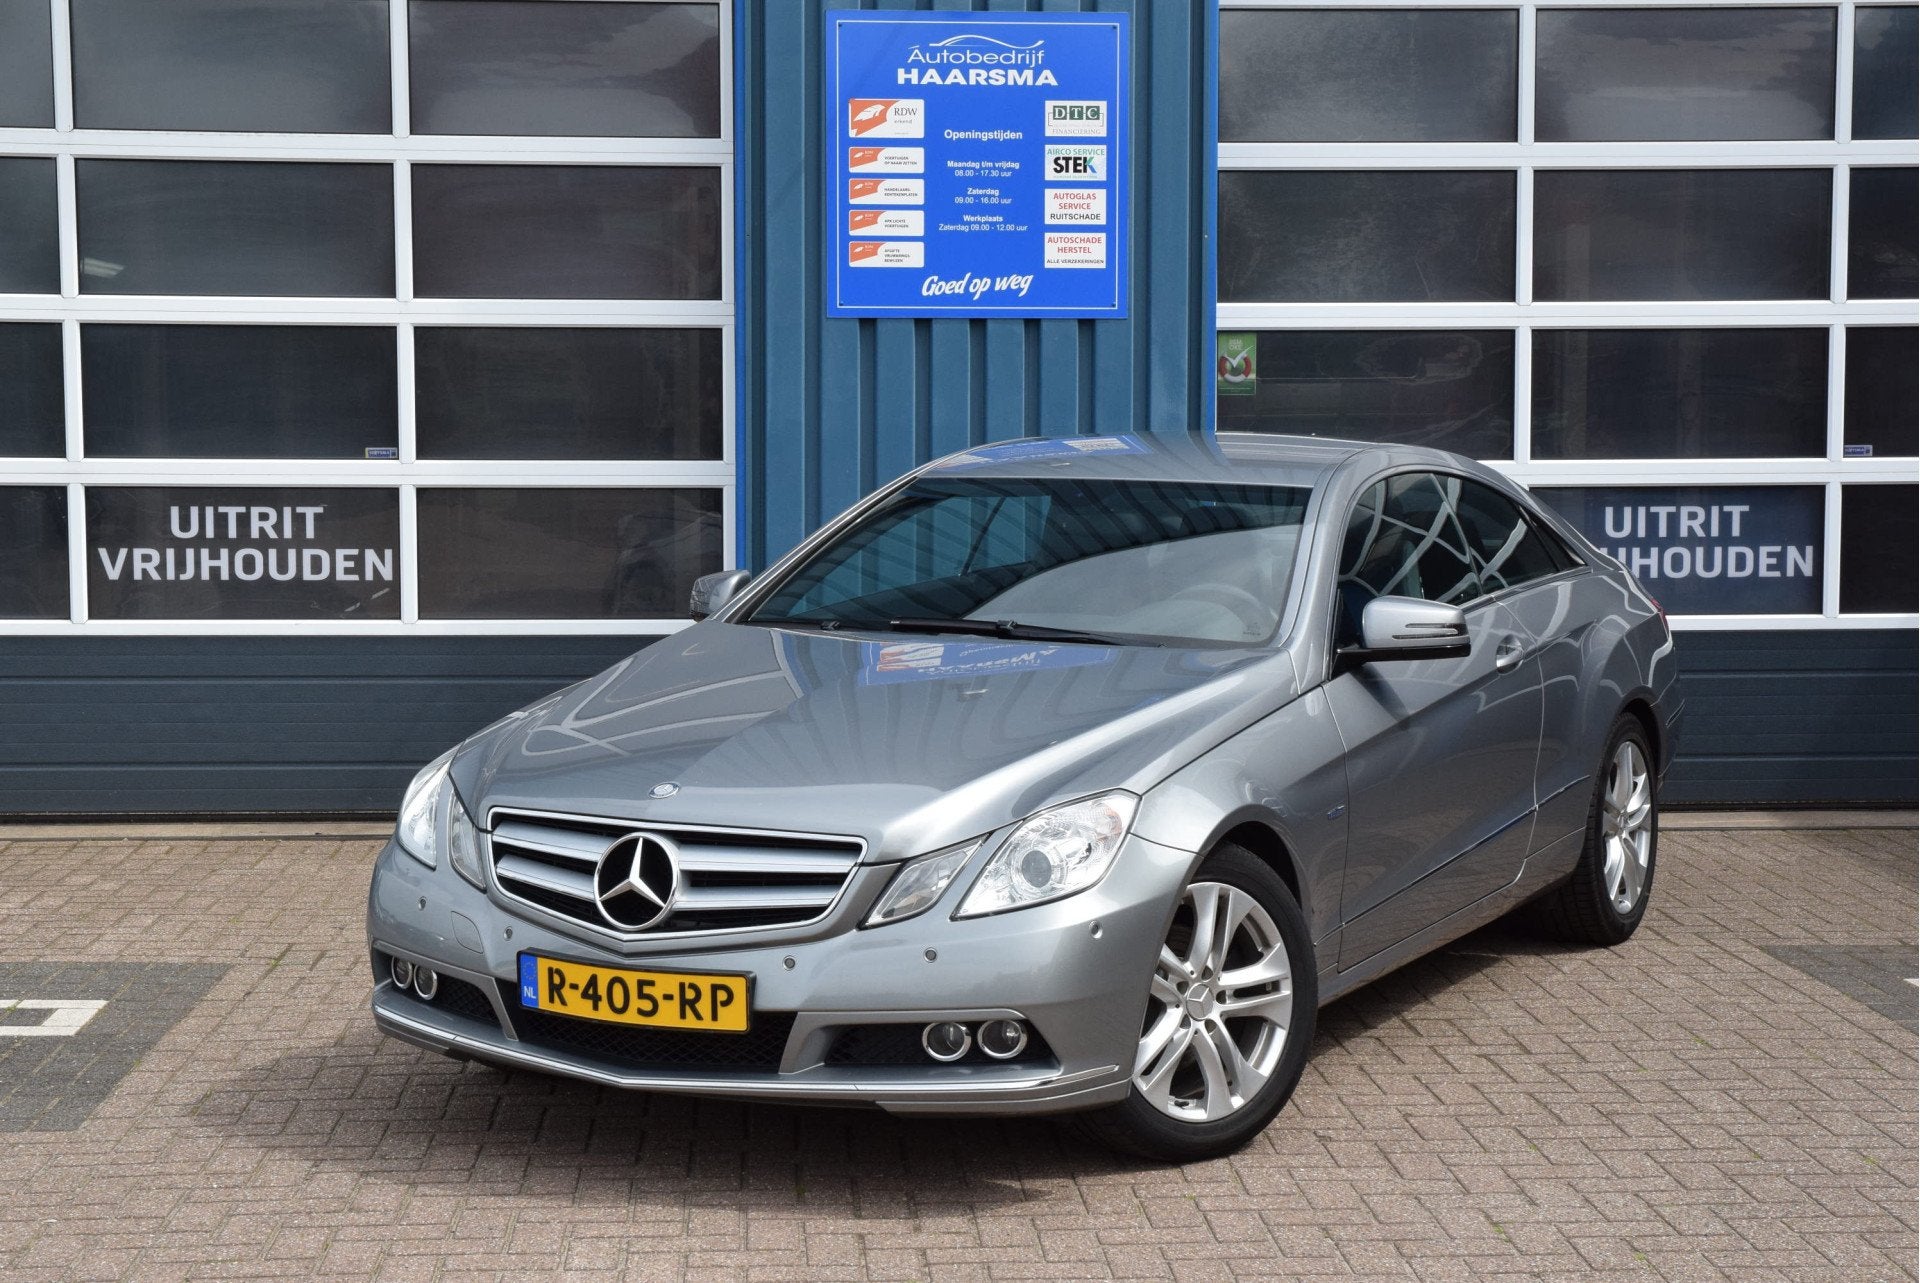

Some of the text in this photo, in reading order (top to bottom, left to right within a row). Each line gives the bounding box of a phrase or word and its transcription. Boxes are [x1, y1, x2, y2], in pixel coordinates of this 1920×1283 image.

[907, 48, 1045, 67] Autobedrijf
[897, 68, 1058, 86] HAARSMA
[894, 107, 917, 116] RDW
[944, 129, 1023, 141] Openingstijden
[1047, 148, 1105, 156] AIRCO SERVICE
[947, 160, 980, 169] Maandag
[995, 161, 1020, 170] vrijdag
[1053, 157, 1097, 174] STEK
[967, 187, 1000, 196] Zaterdag
[1058, 202, 1091, 210] SERVICE
[963, 214, 1004, 223] Werkplaats
[1050, 213, 1101, 221] RUITSCHADE
[938, 223, 970, 232] Zaterdag
[1047, 236, 1102, 244] AUTOSCHADE
[1057, 246, 1092, 254] HERSTEL
[921, 271, 1034, 300] Goed op weg
[170, 506, 324, 539] UITRIT
[1605, 505, 1750, 538] UITRIT
[97, 547, 394, 581] VRIJHOUDEN
[523, 986, 536, 999] NL
[547, 966, 735, 1022] R-405-RP
